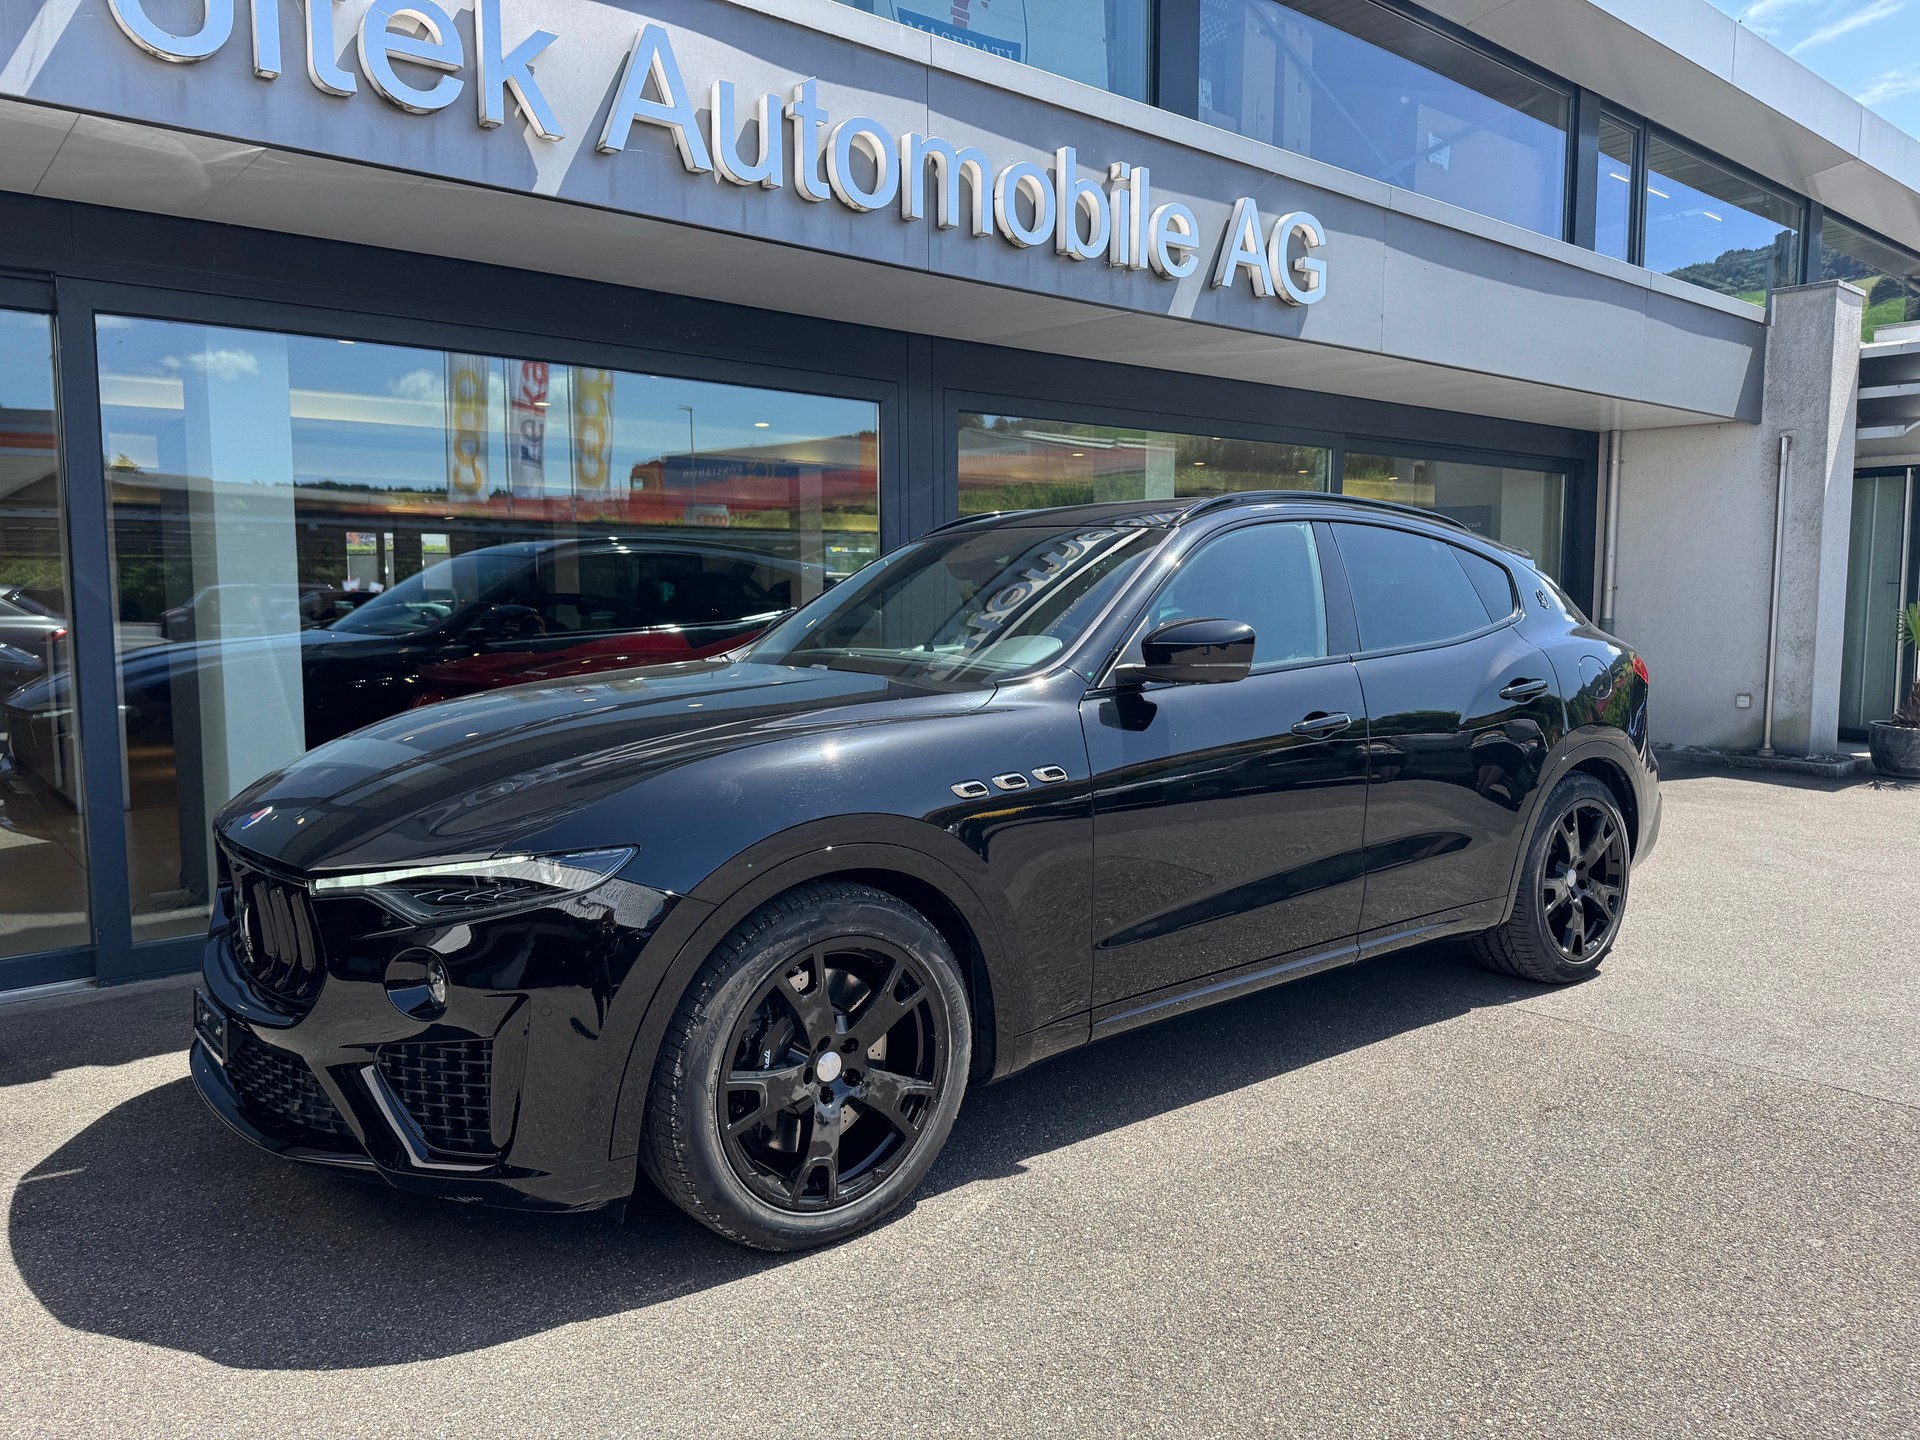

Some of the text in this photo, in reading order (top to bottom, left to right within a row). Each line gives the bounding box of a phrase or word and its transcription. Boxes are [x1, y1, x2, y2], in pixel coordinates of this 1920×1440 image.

[597, 22, 1200, 282] Automobile
[1211, 197, 1328, 307] AG
[511, 360, 549, 470] reka
